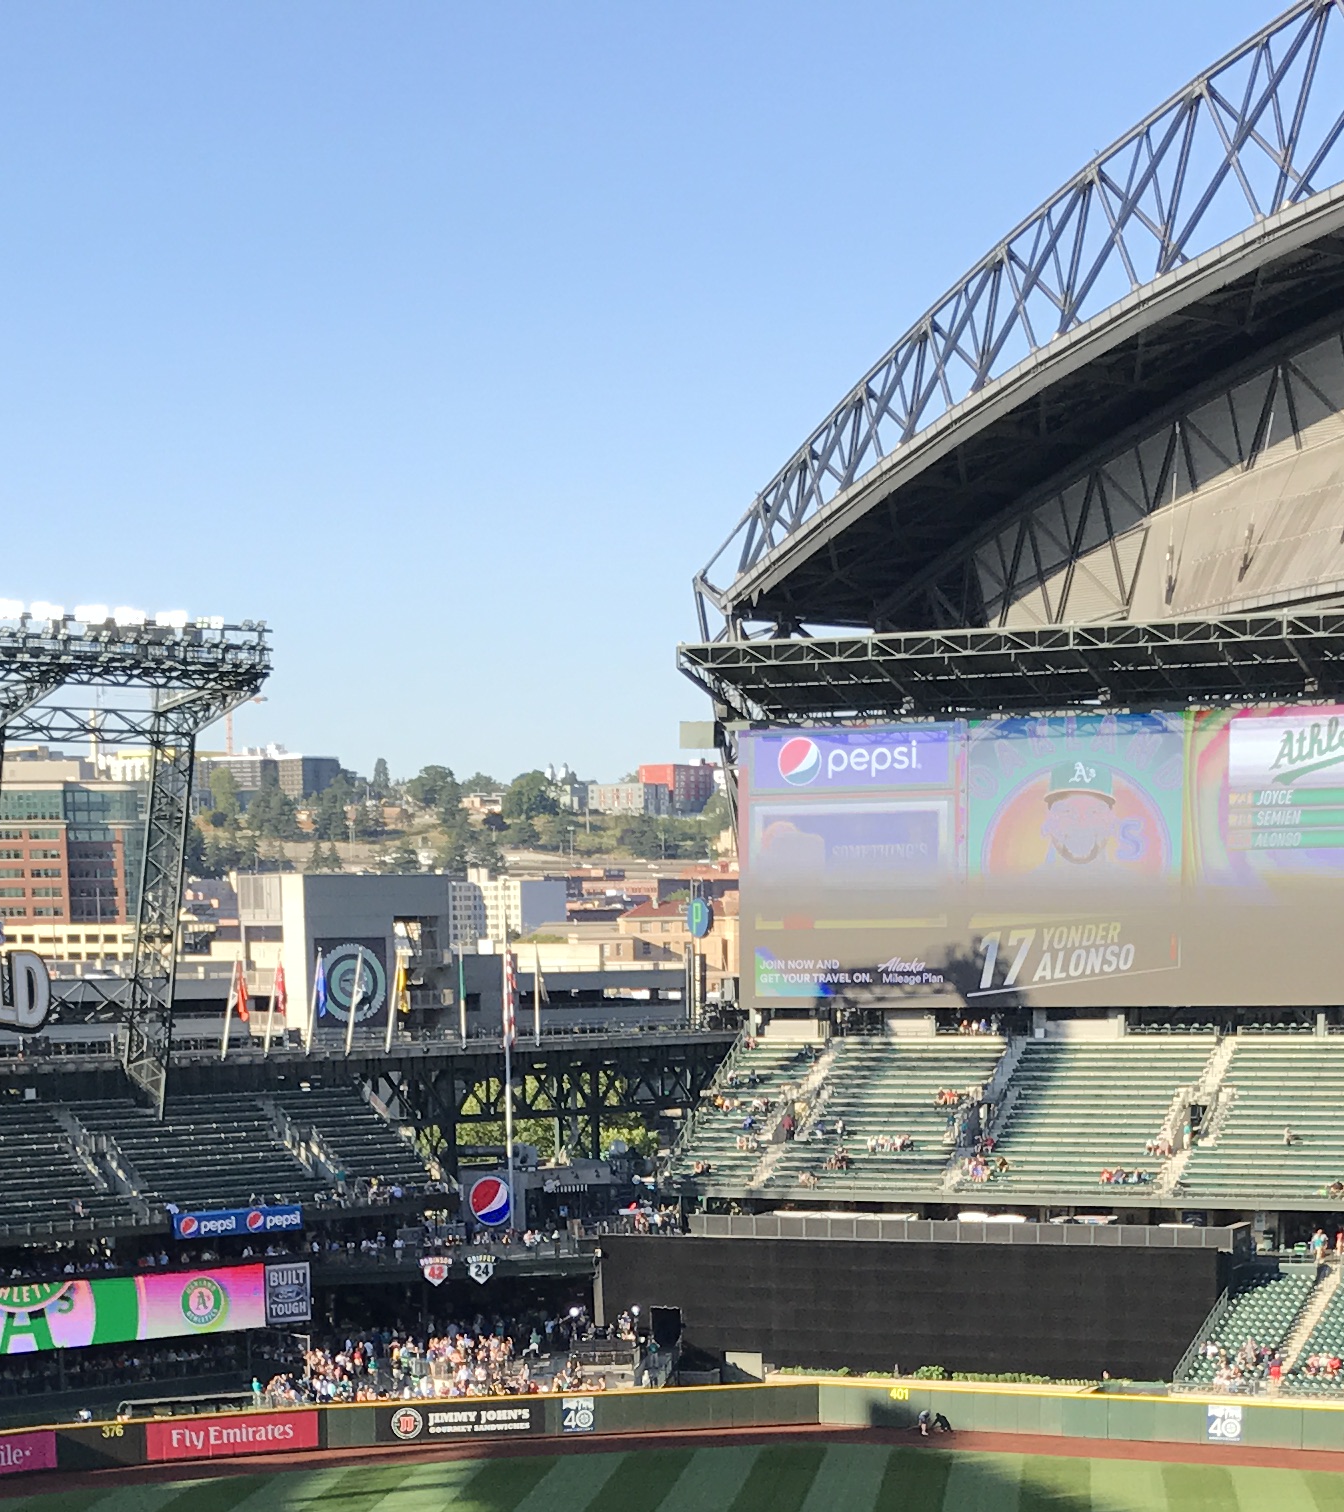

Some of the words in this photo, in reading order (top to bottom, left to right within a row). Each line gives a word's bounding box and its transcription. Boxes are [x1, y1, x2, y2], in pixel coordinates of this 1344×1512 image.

[827, 740, 918, 779] pepsi
[1257, 790, 1293, 805] JOYCE
[1257, 810, 1301, 826] SEMIEN
[1255, 832, 1301, 847] ALONSO
[1043, 922, 1121, 950] YONDER
[760, 960, 785, 970] JOIN
[788, 960, 814, 969] NOW
[816, 960, 839, 969] AND
[878, 957, 925, 973] Alaska
[979, 928, 1036, 990] 17
[1033, 943, 1135, 982] ALONSO
[760, 974, 780, 983] GET
[782, 974, 810, 983] YOUR
[813, 973, 851, 983] TRAVEL
[853, 973, 872, 983] ON.
[883, 973, 921, 985] Mileage
[923, 973, 943, 983] Plan
[201, 1216, 236, 1235] pepsi
[266, 1211, 301, 1229] pepsi
[269, 1270, 305, 1286] BUILT
[429, 1266, 444, 1279] 42
[474, 1264, 489, 1277] 24
[271, 1302, 306, 1316] TOUGH
[428, 1411, 477, 1426] JIMMY
[480, 1409, 530, 1423] JOHN'S
[563, 1410, 594, 1428] 40
[102, 1426, 124, 1438] 376
[429, 1424, 472, 1434] GOURMET
[474, 1422, 531, 1432] SANDWICHES
[1209, 1418, 1241, 1437] 40
[171, 1428, 204, 1450] Fly
[209, 1423, 293, 1445] Emirates
